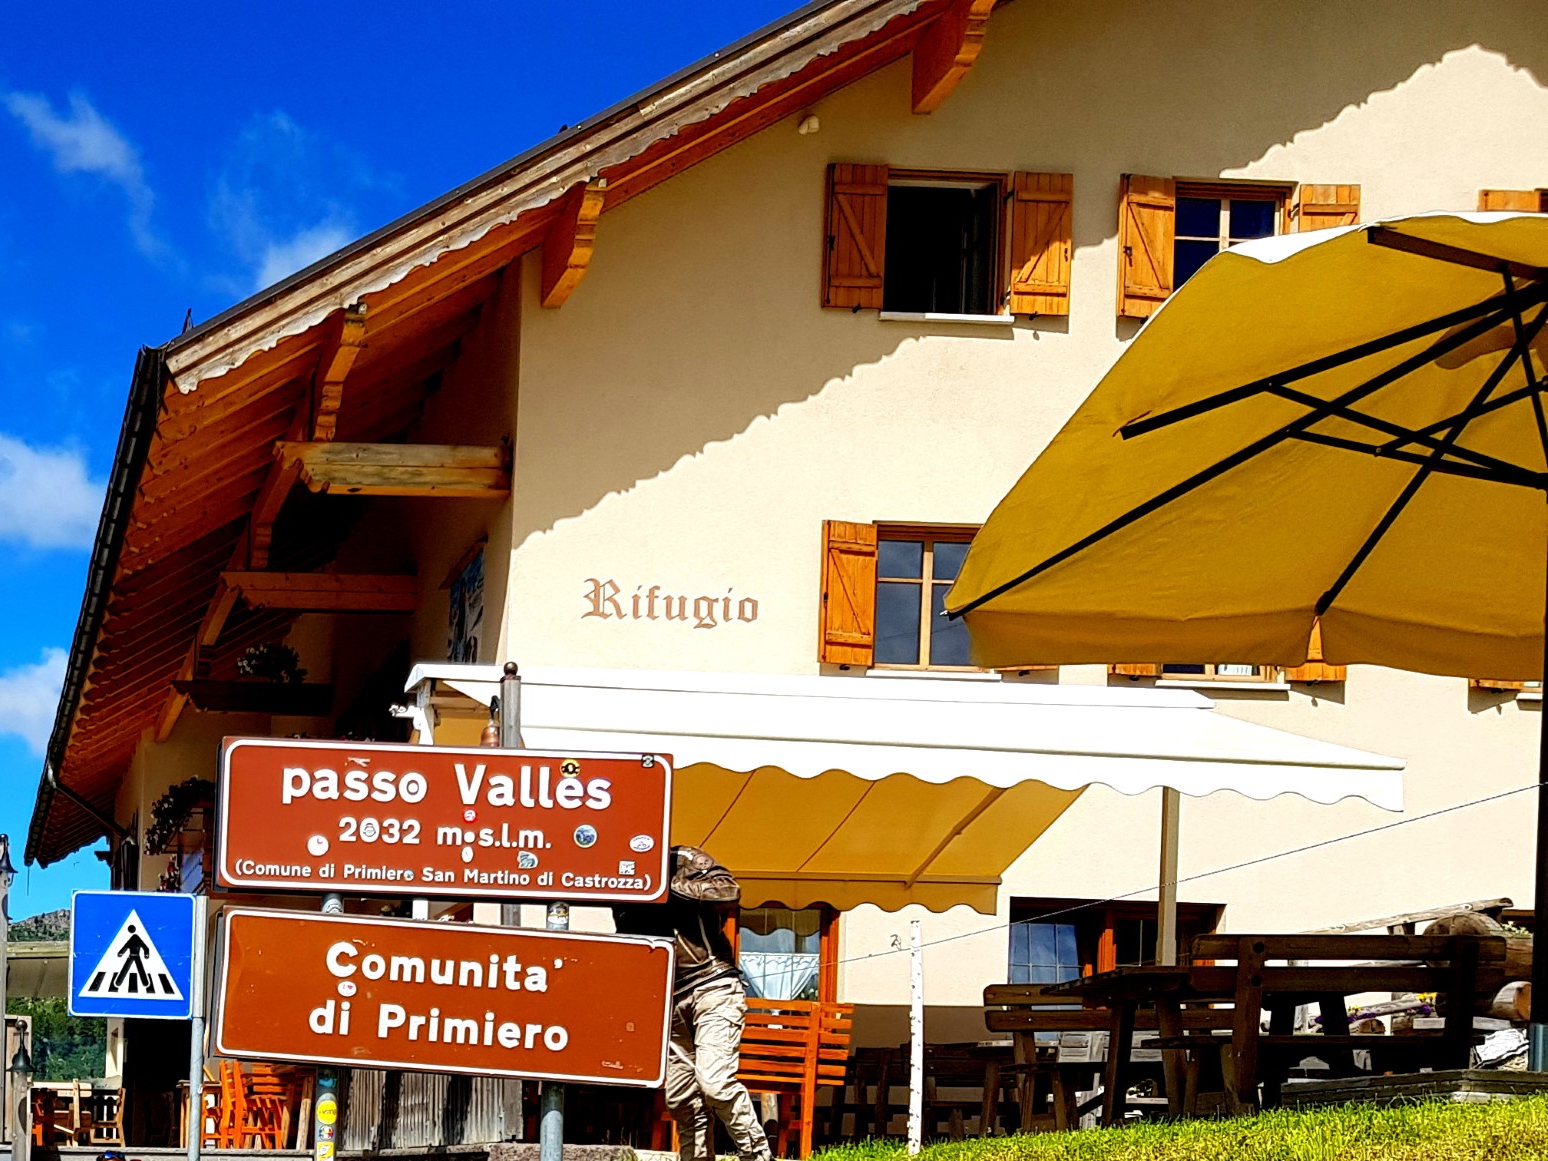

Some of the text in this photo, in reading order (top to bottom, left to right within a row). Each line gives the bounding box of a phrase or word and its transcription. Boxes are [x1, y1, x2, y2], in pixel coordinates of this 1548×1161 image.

[581, 577, 759, 629] Rifugio
[281, 762, 612, 810] passo Valles
[338, 816, 420, 845] 2032
[234, 858, 651, 891] (Comune di Primiero San Martino di Castrozza)
[309, 1000, 569, 1051] di Primiero
